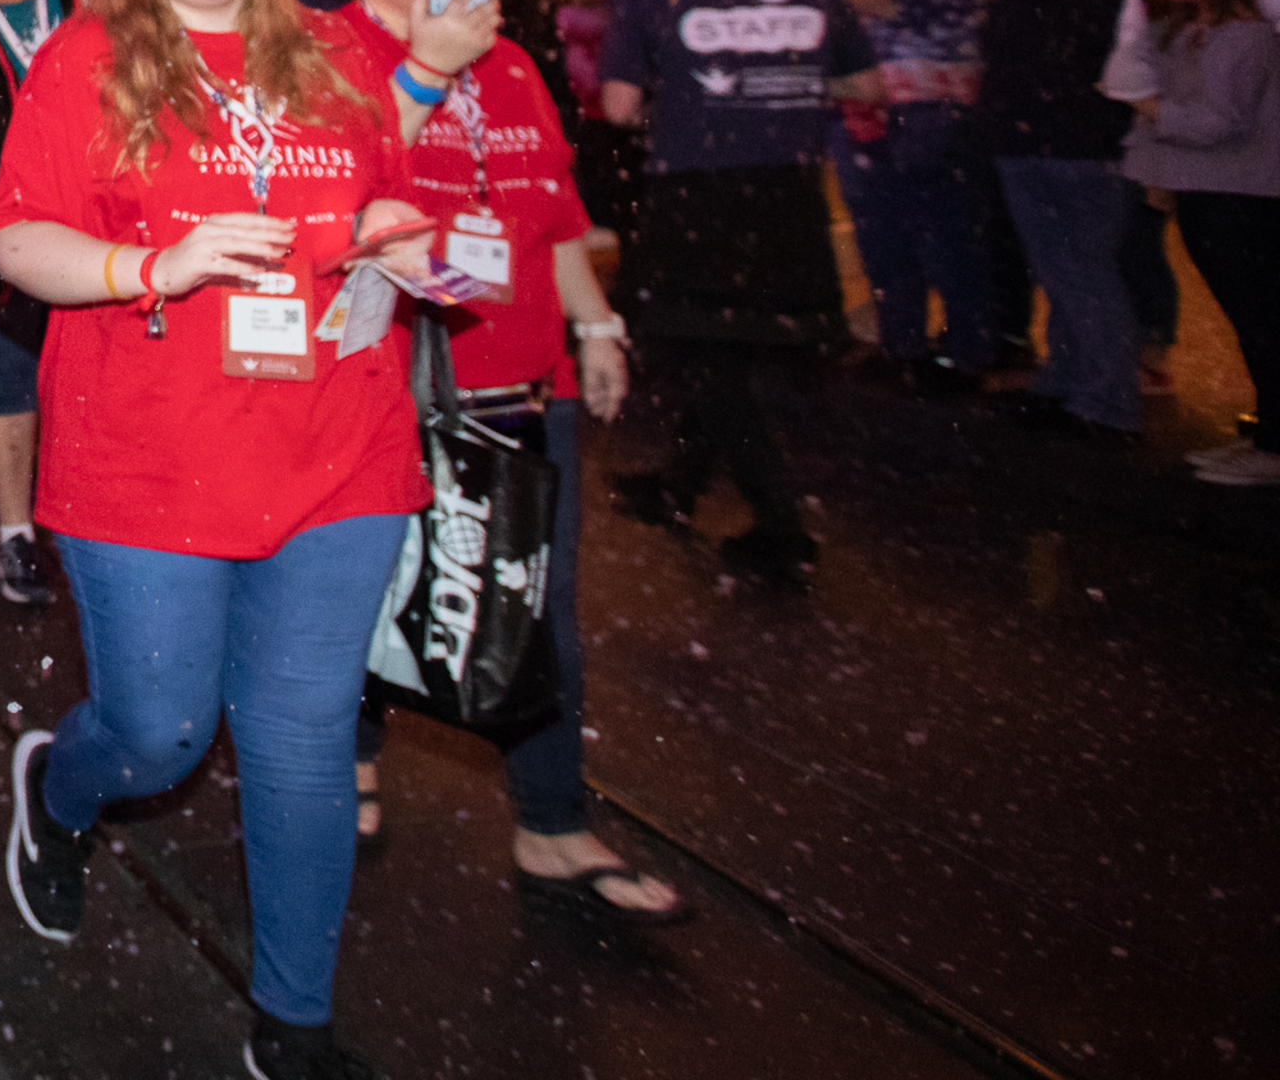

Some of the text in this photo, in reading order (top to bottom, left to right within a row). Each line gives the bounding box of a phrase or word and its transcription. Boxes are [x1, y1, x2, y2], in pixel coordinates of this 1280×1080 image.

[694, 14, 813, 43] STAFF
[272, 145, 357, 169] SINISE
[214, 163, 338, 179] FOUATION
